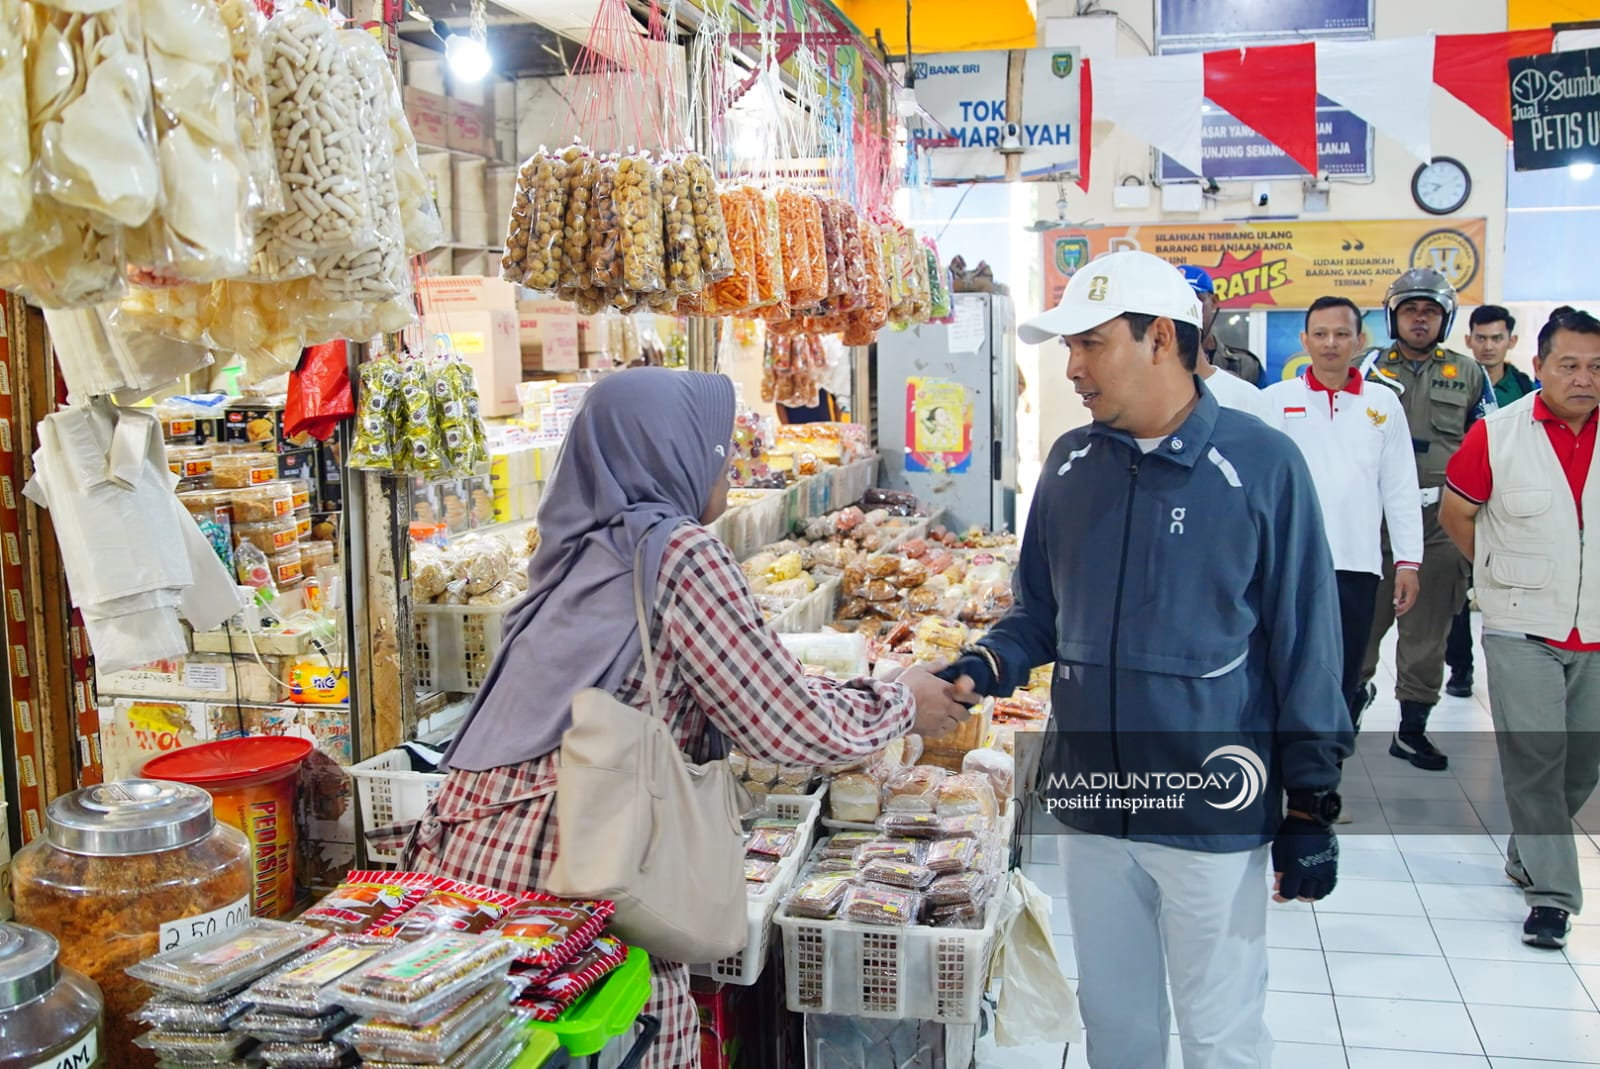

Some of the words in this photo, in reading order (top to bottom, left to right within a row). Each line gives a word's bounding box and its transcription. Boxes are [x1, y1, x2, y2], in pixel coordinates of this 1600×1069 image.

[928, 65, 960, 76] BANK
[962, 63, 980, 74] BRI
[1544, 65, 1600, 103] Sumb
[959, 100, 1007, 122] TOK
[950, 123, 1071, 148] MARYAH
[1201, 126, 1227, 138] ASAR
[1531, 111, 1583, 152] PETIS
[1587, 110, 1600, 146] U
[1155, 232, 1205, 243] SILAHKAN
[1208, 231, 1255, 241] TIMBANG
[1257, 230, 1293, 240] ULANG
[1155, 244, 1198, 253] BARANG
[1201, 242, 1260, 252] BELANJAAN
[1263, 241, 1293, 251] ANDA
[1312, 258, 1344, 267] SUDAH
[1346, 257, 1395, 266] SESUAIKAH
[1305, 269, 1344, 277] BARANG
[1347, 268, 1373, 276] YANG
[1375, 267, 1402, 276] ANDA
[1213, 258, 1288, 302] RATIS
[1334, 279, 1367, 287] TERIMA
